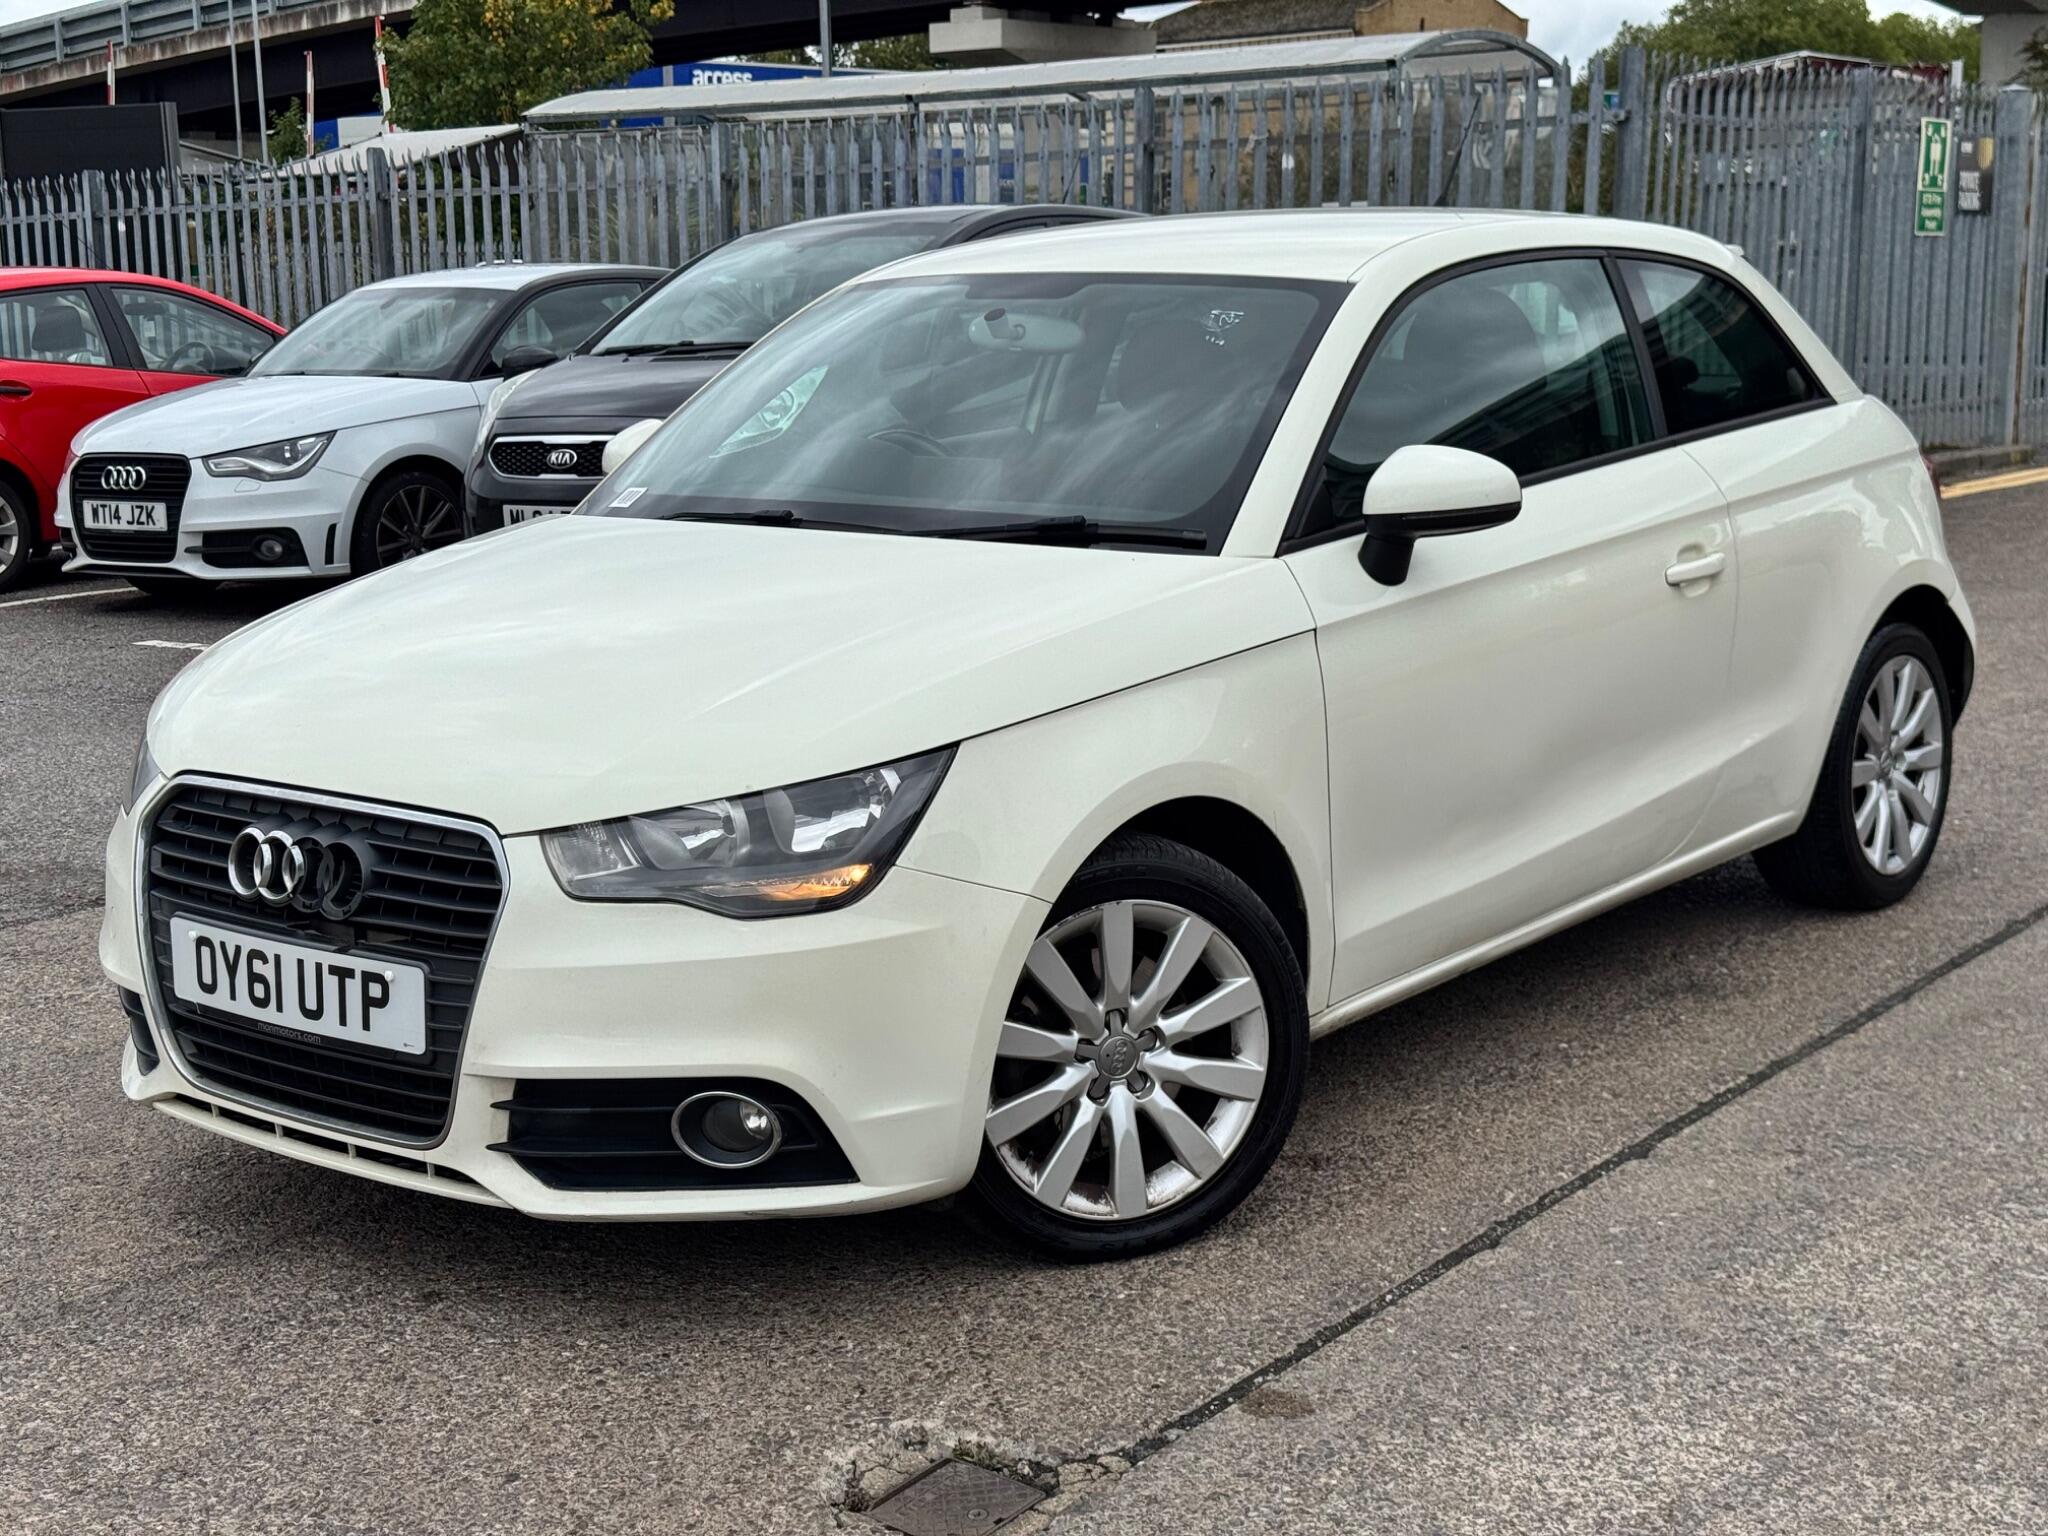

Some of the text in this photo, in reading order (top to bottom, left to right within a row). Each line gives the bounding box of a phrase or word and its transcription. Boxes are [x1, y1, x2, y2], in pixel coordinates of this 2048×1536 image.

[692, 69, 753, 86] access
[550, 452, 571, 464] KIA
[91, 503, 156, 526] WT14 JZK
[195, 935, 391, 1032] OY61 UTP
